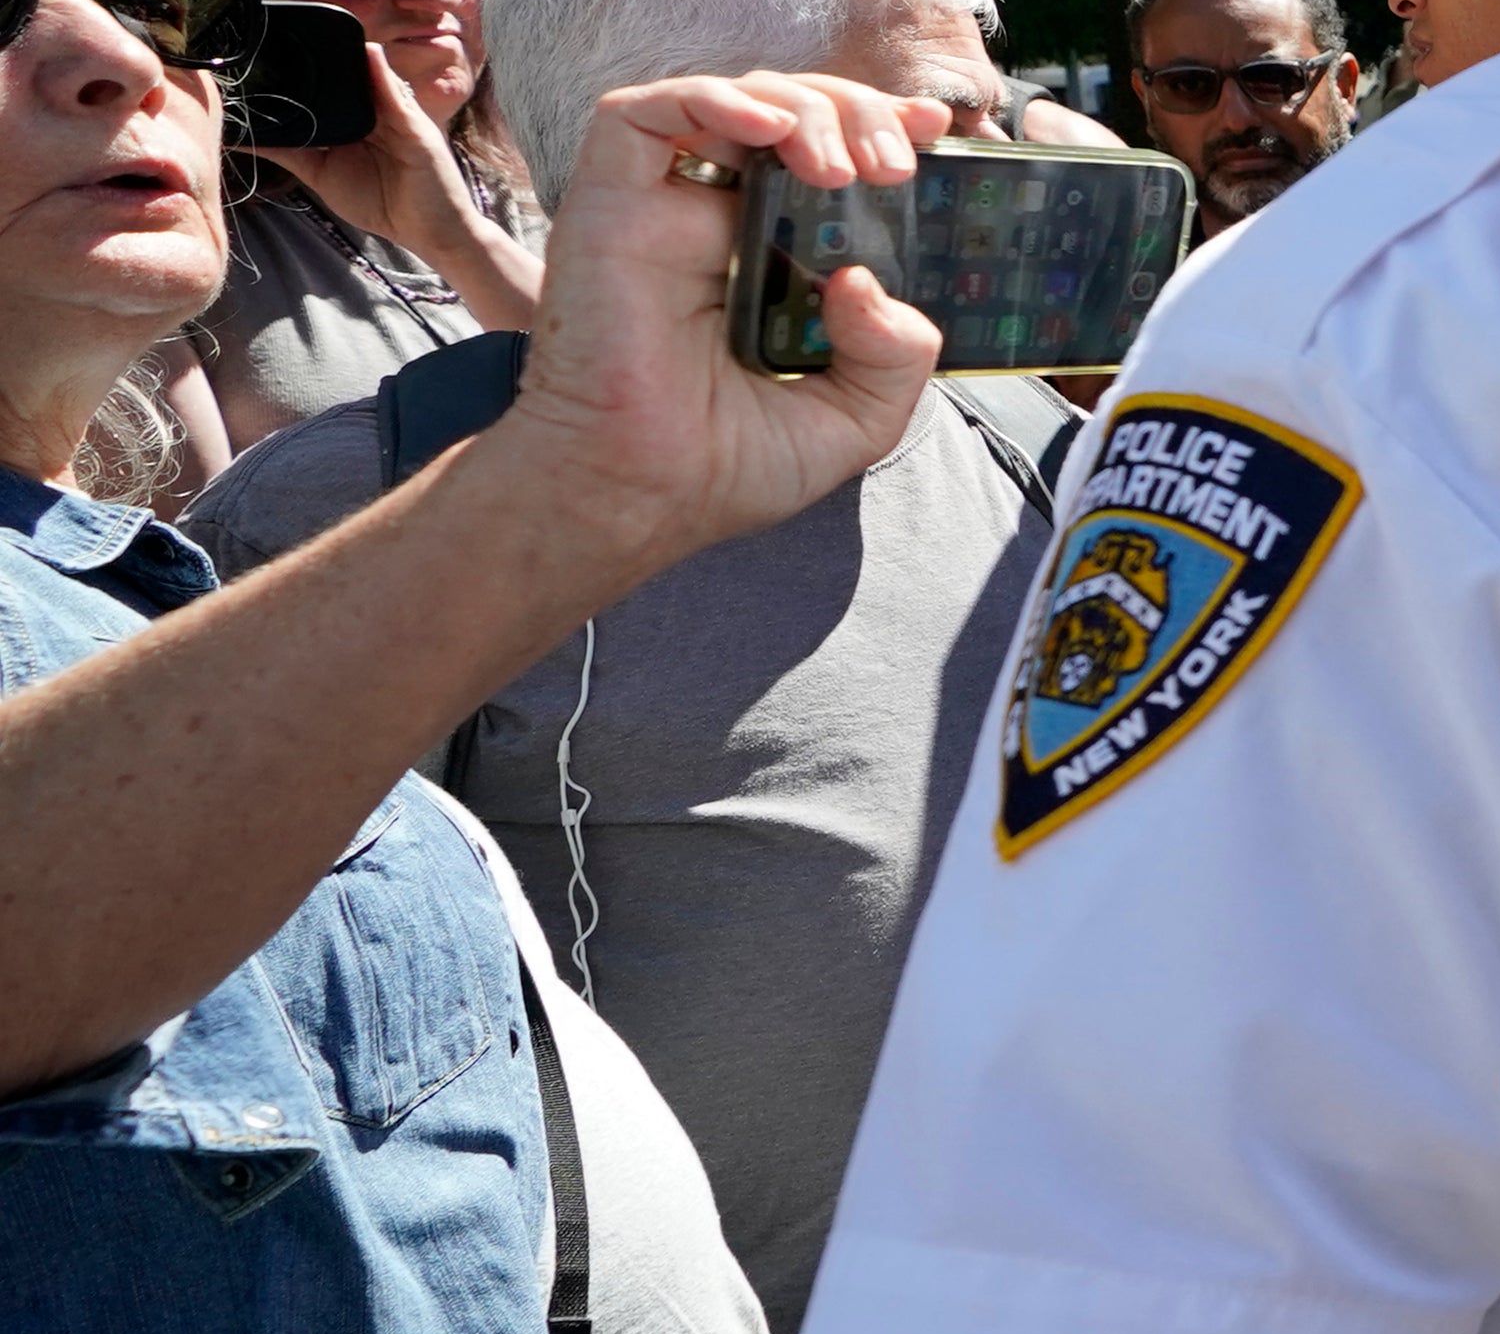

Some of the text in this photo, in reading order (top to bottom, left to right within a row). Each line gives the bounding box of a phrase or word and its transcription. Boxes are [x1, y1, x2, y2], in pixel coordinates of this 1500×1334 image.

[1106, 420, 1257, 488] POLICE
[1052, 705, 1150, 797] NEW
[1147, 587, 1270, 712] YORK
